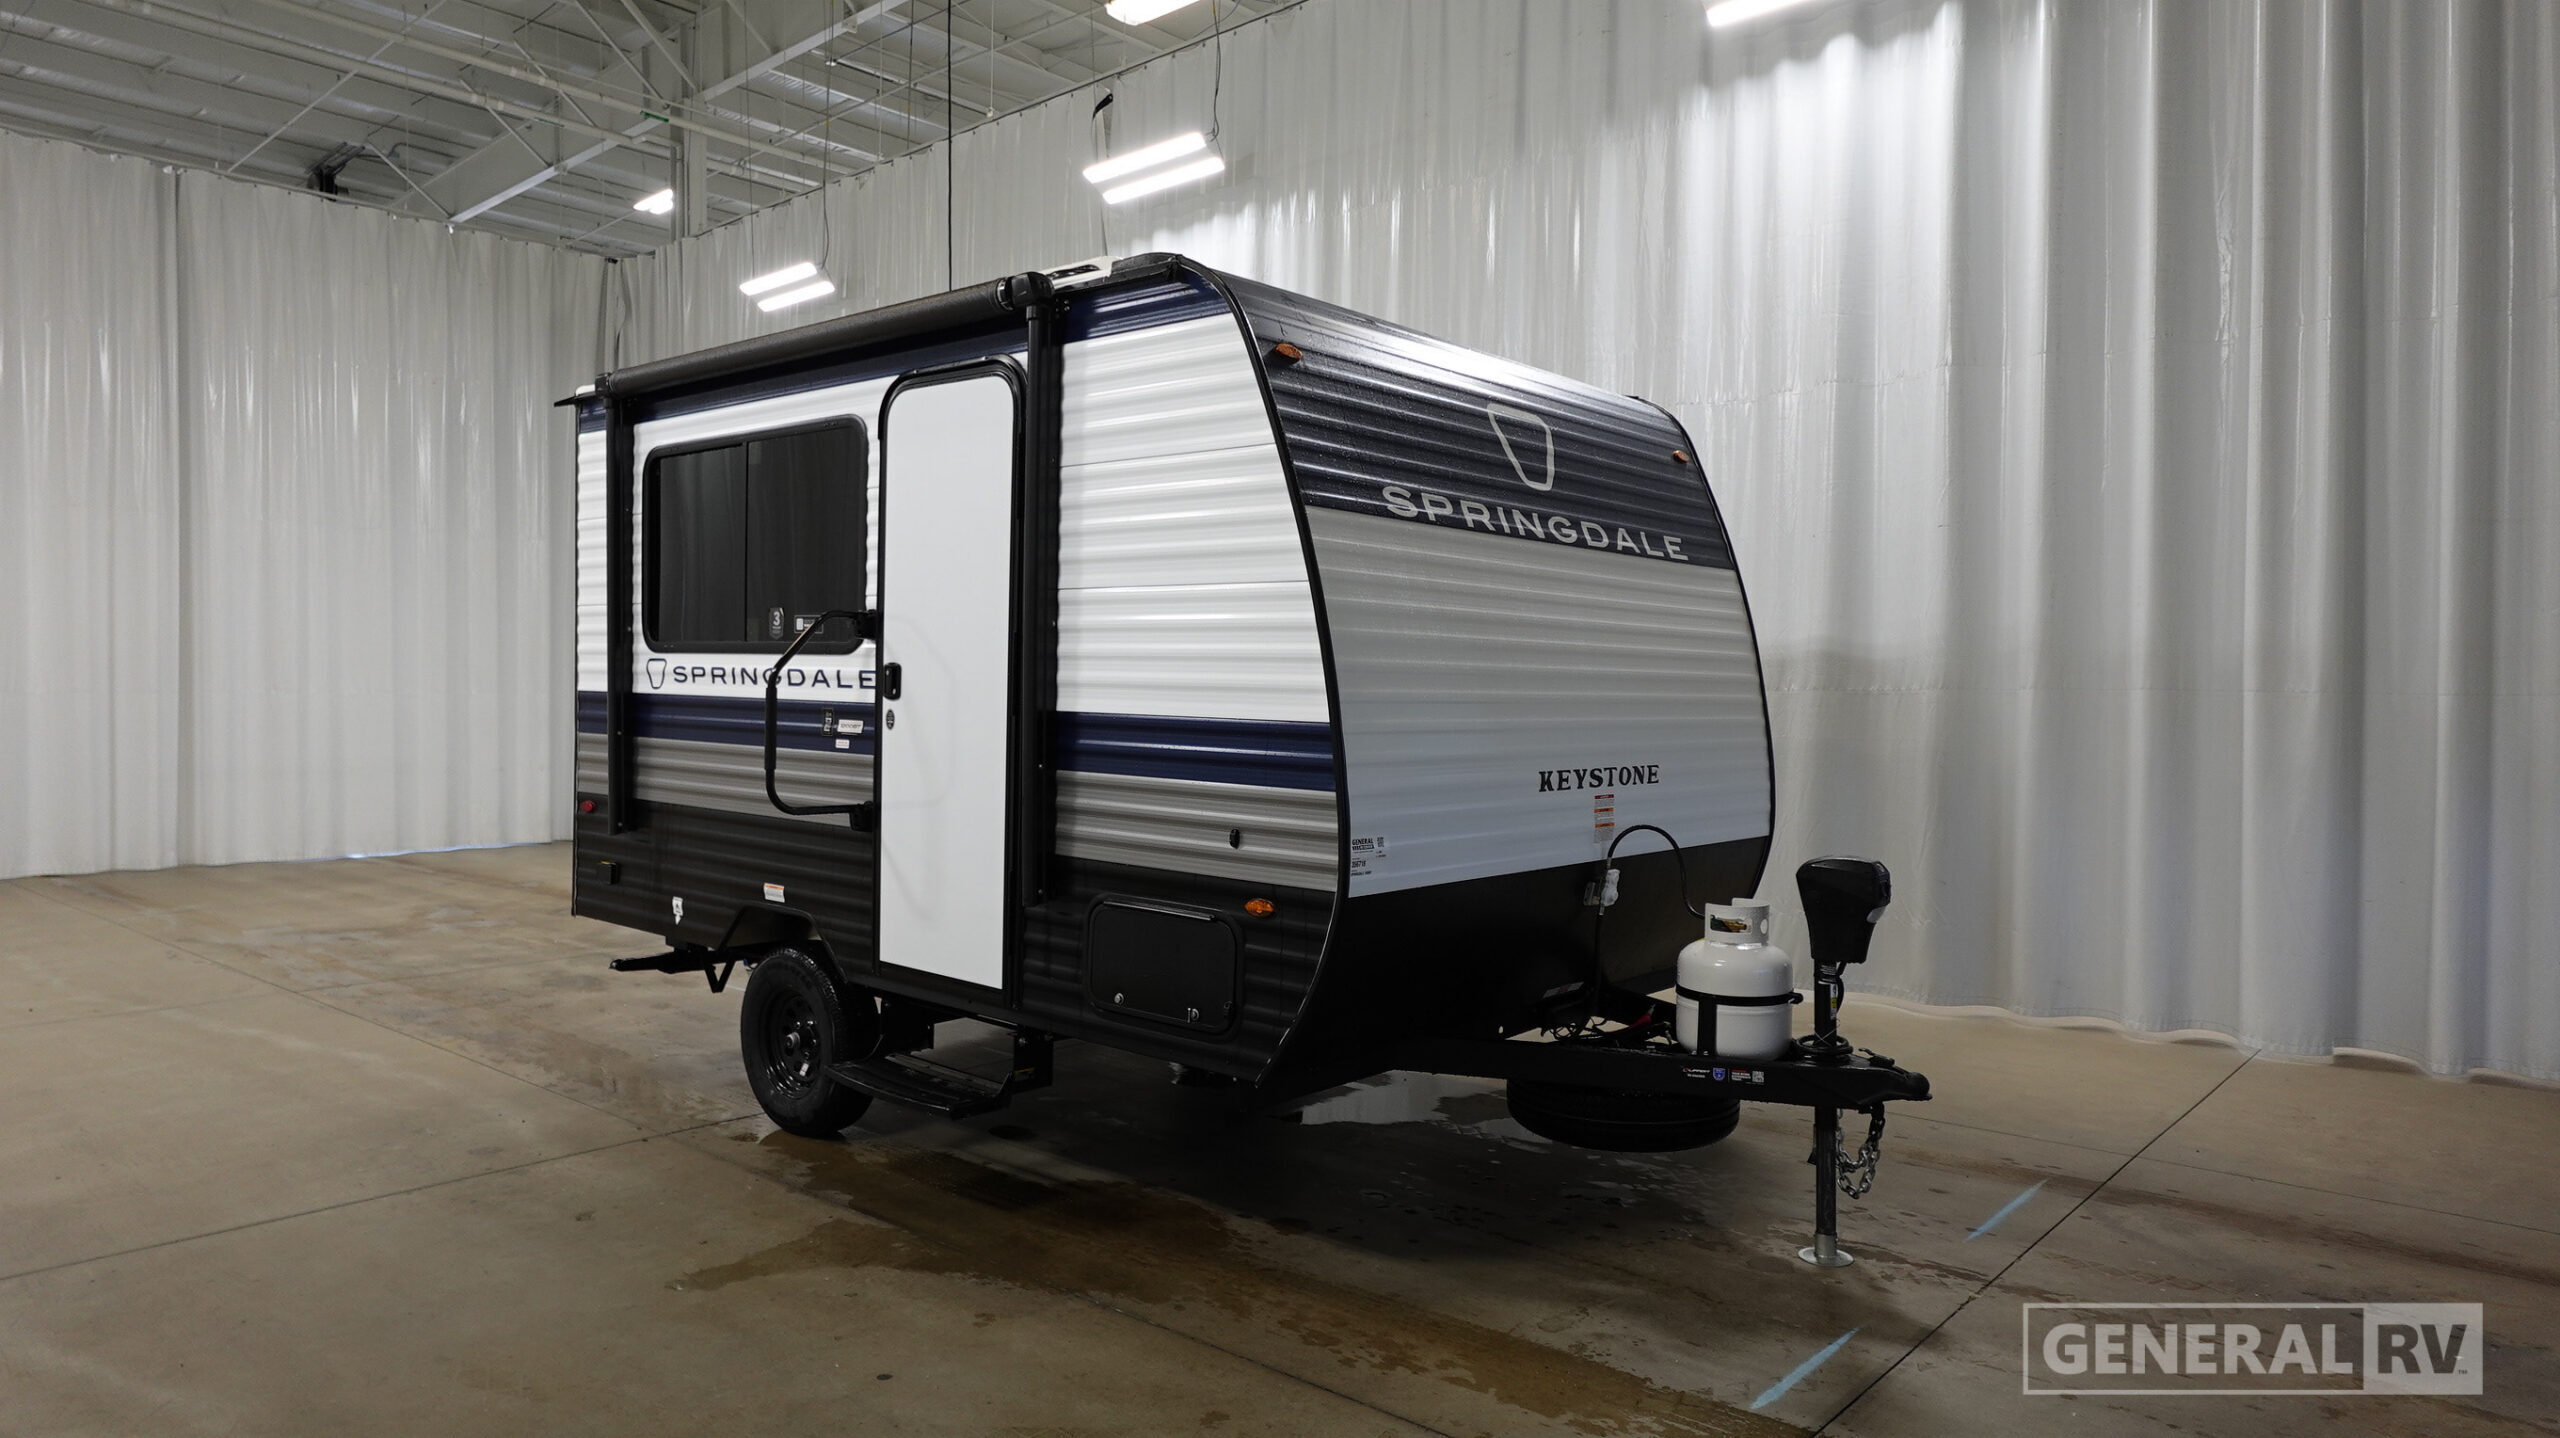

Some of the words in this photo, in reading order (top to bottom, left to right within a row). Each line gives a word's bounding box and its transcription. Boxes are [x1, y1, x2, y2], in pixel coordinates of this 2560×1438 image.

[1382, 485, 1689, 561] SPRINGDALE
[773, 611, 780, 626] 3
[673, 666, 876, 690] SPRINGDALE
[1538, 764, 1660, 792] KEYSTONE
